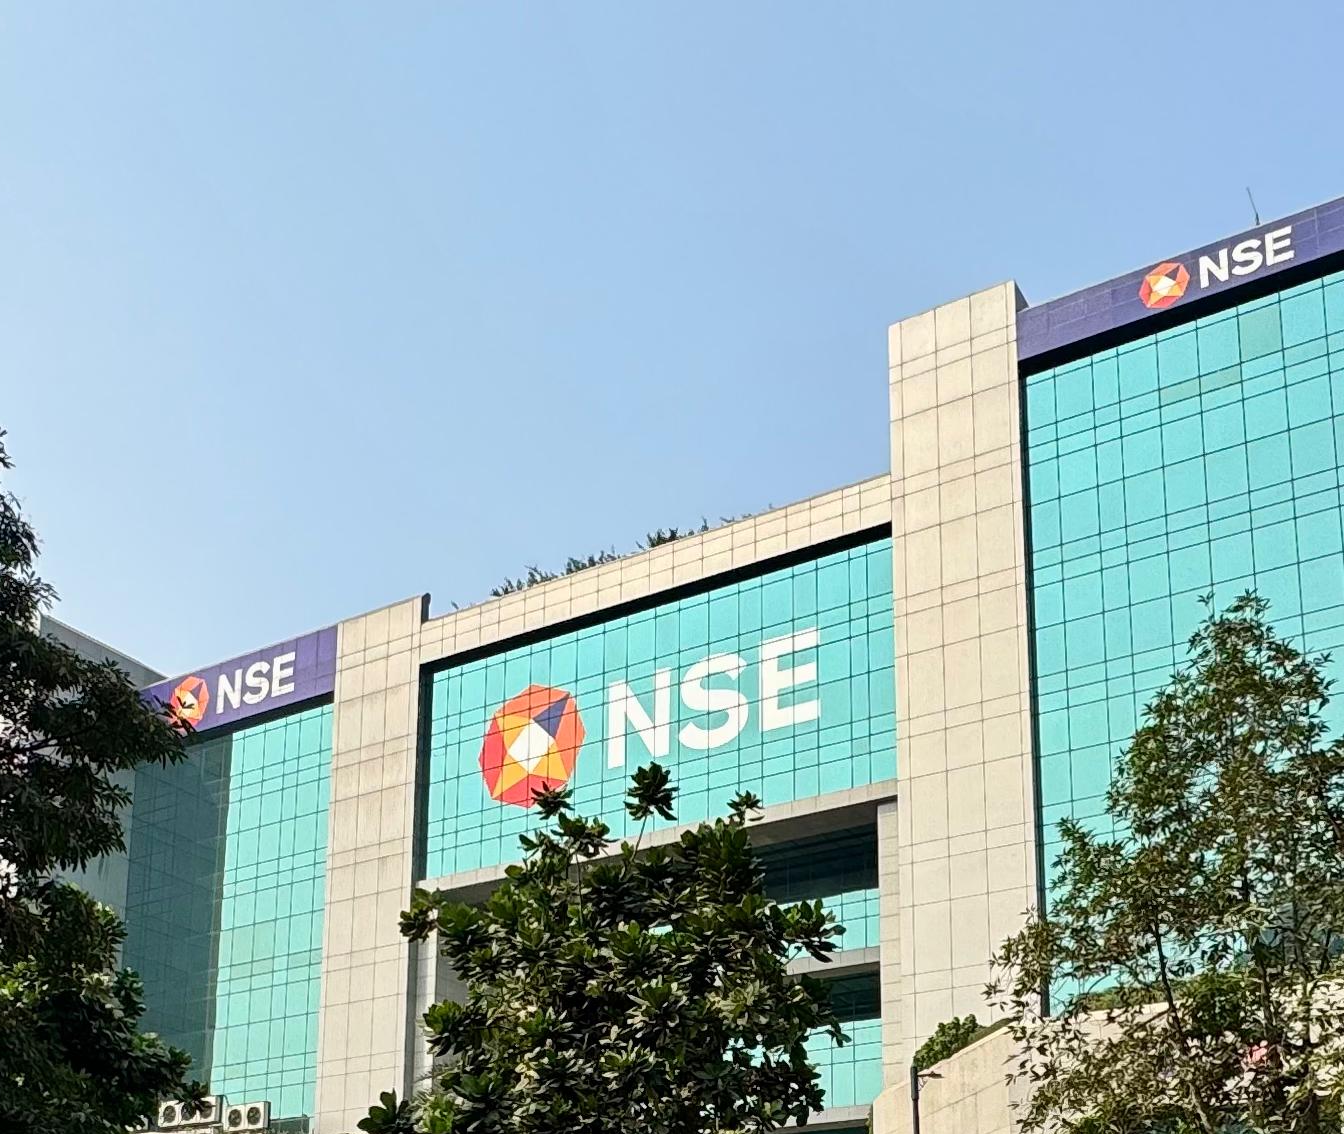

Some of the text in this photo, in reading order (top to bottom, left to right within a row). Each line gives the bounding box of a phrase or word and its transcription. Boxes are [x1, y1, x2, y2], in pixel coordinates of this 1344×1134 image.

[1199, 226, 1295, 289] NSE
[216, 652, 295, 714] NSE
[608, 627, 821, 769] NSE
